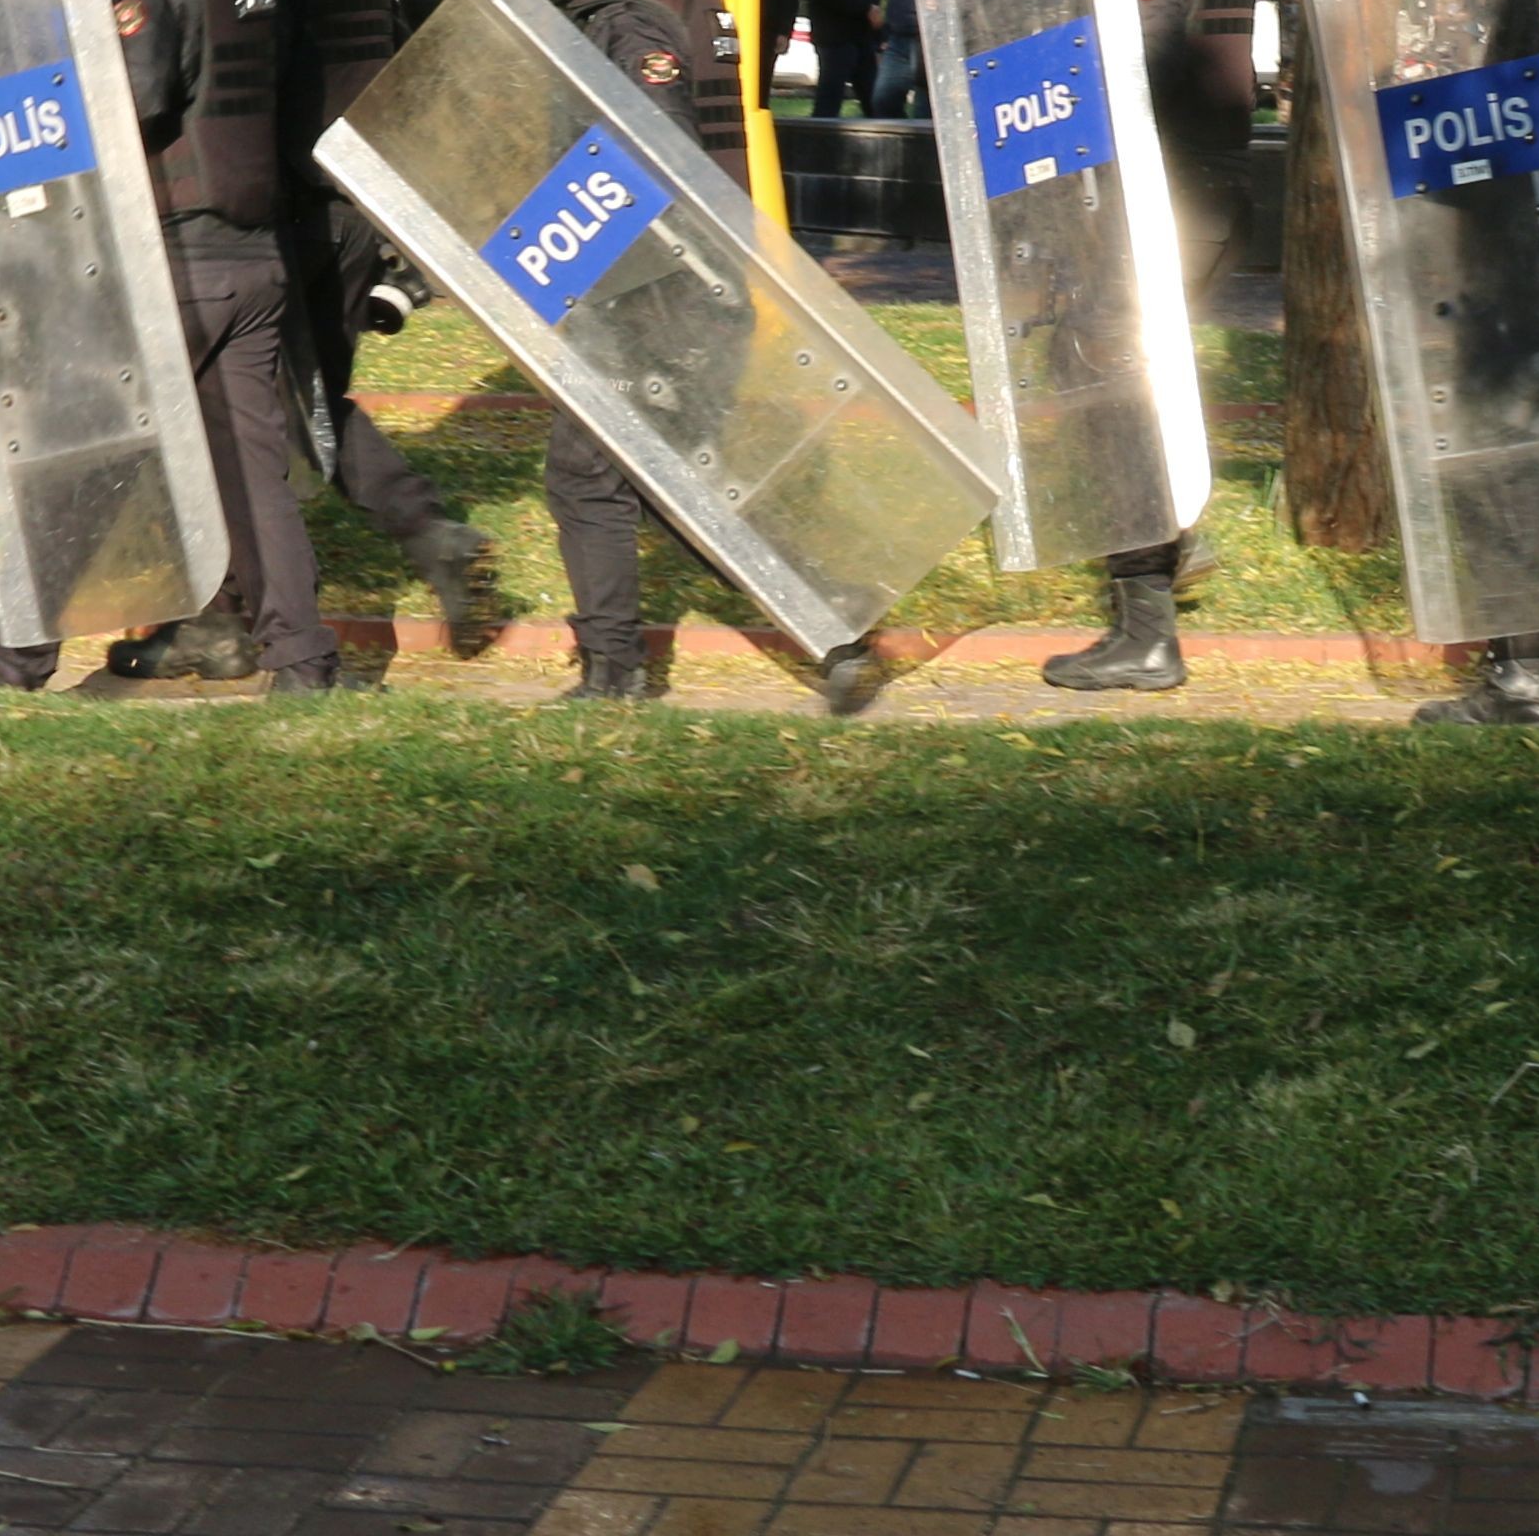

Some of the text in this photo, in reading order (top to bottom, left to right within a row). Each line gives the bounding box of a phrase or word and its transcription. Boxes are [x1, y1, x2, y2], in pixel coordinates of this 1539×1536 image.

[994, 80, 1074, 140] POLİS
[1404, 92, 1534, 160] POLİS
[516, 170, 628, 287] POLİS
